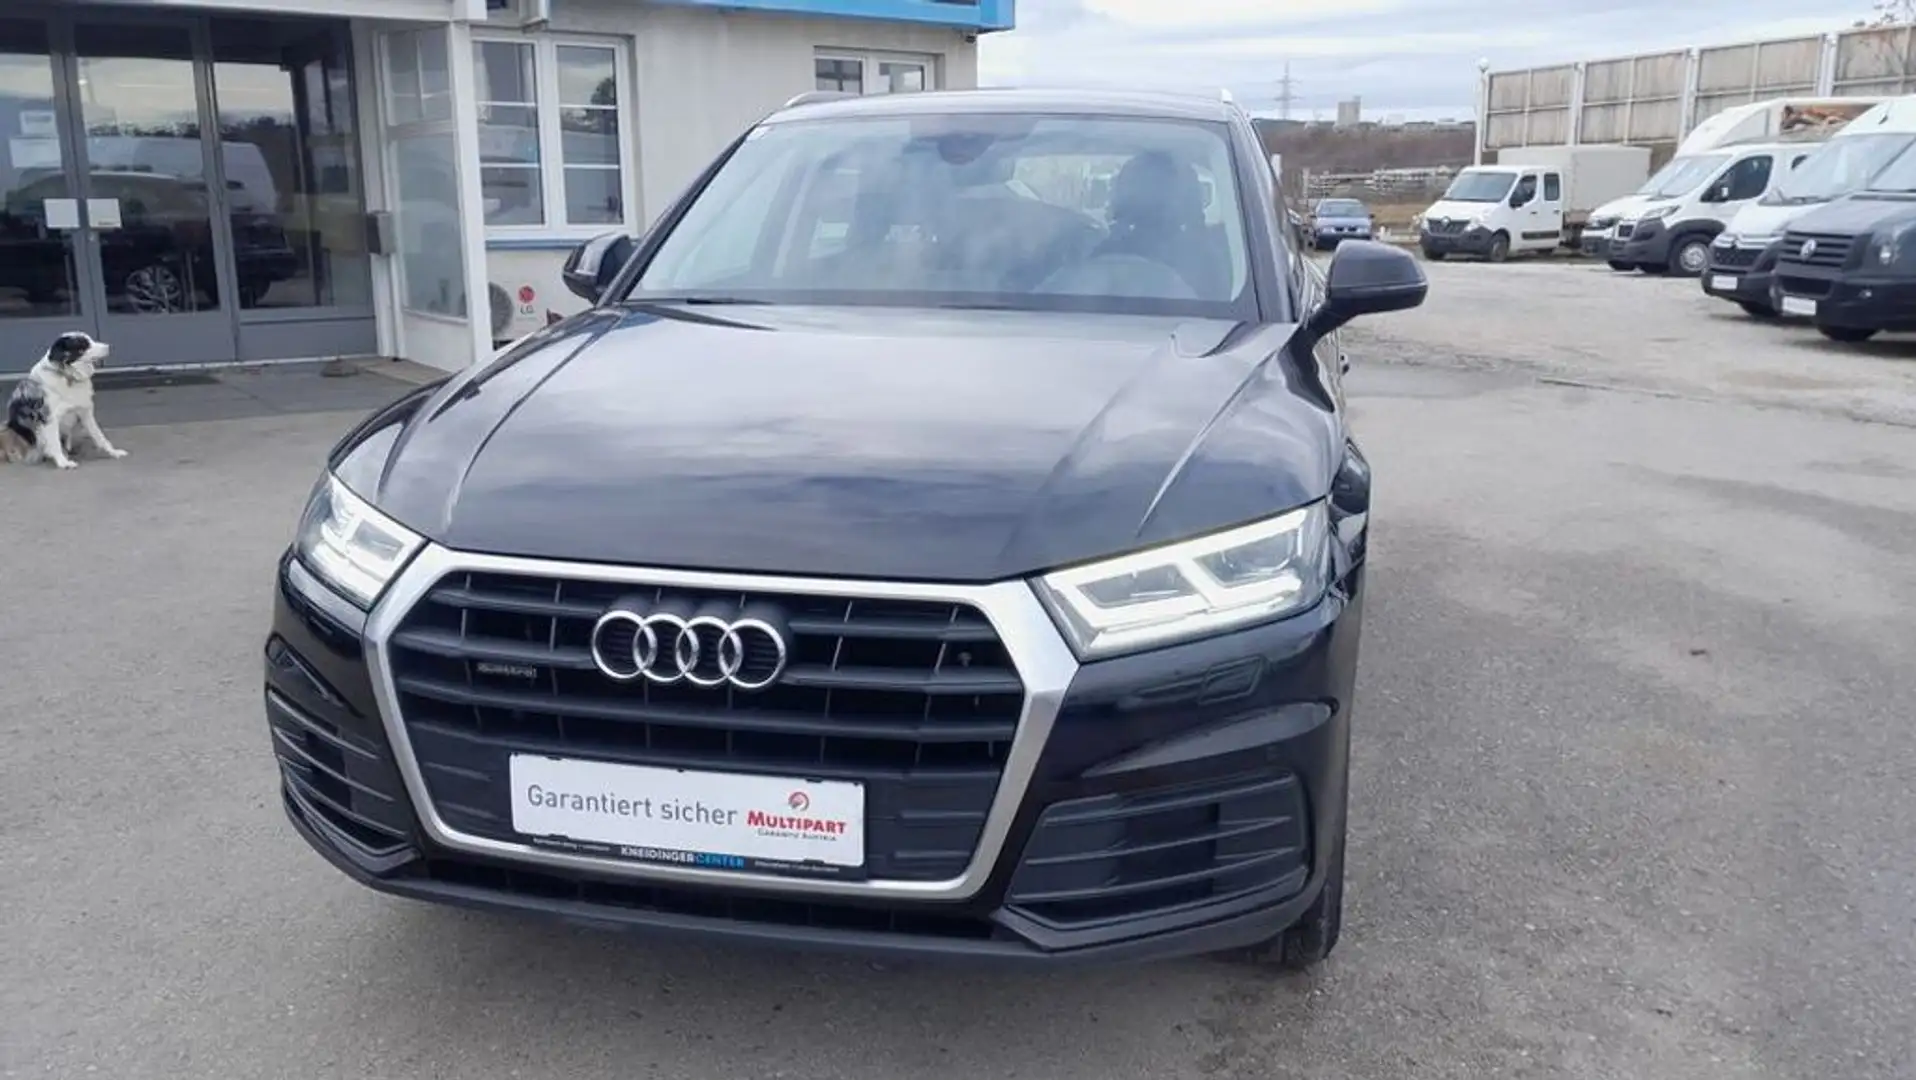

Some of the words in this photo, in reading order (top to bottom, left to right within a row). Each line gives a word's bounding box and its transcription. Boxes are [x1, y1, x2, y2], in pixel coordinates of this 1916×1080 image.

[519, 304, 535, 315] LG
[528, 784, 652, 818] Garantiert
[660, 798, 738, 825] sicher
[747, 810, 846, 834] MULTIPART
